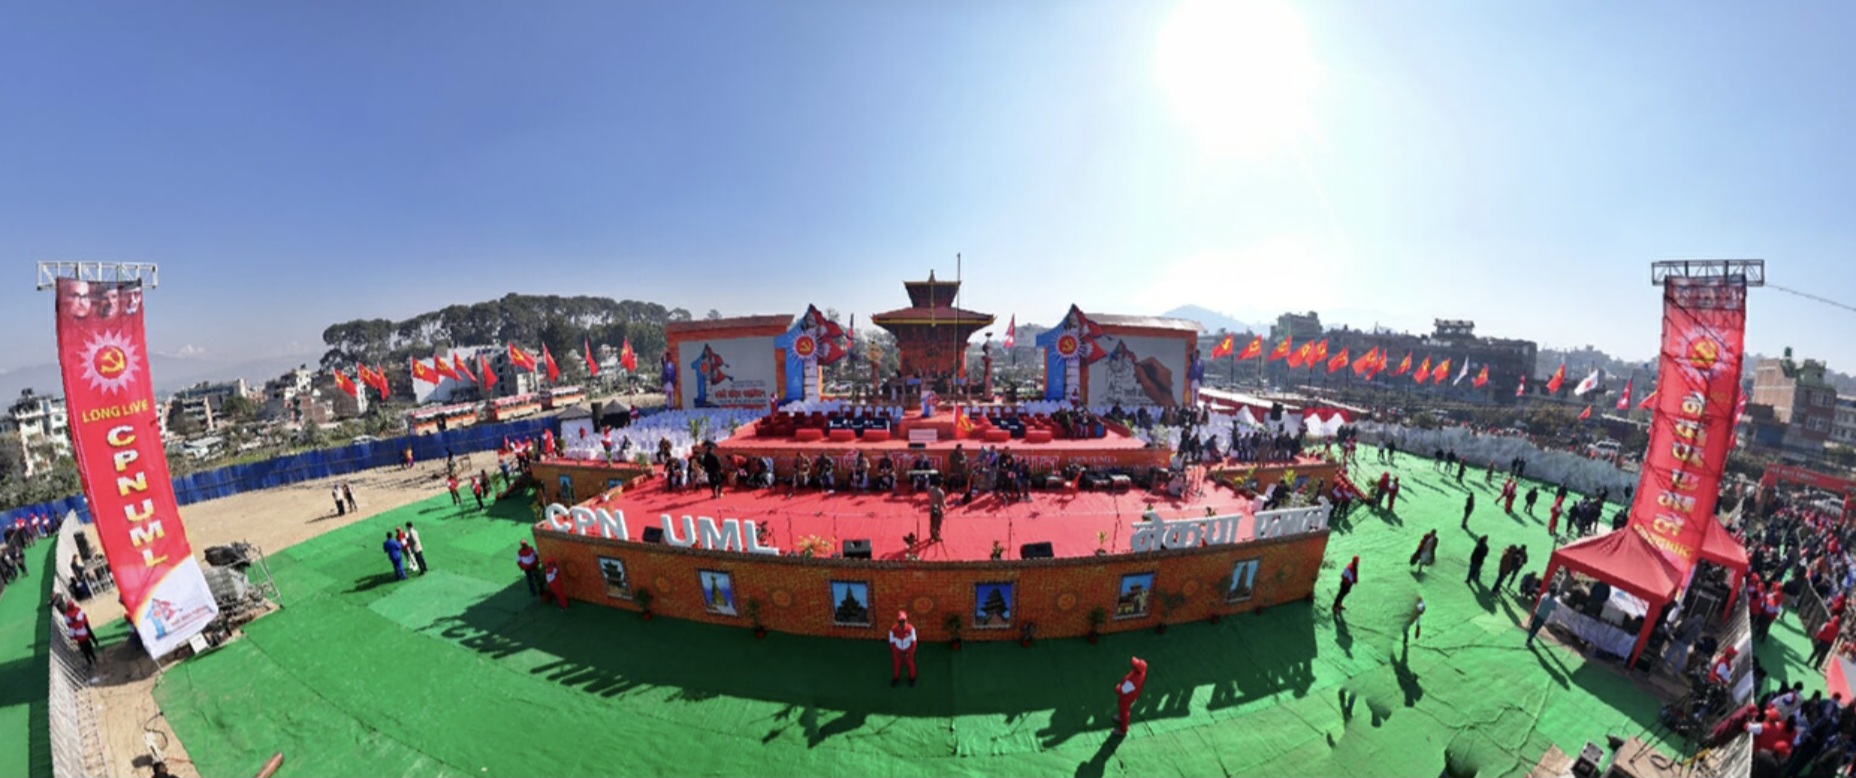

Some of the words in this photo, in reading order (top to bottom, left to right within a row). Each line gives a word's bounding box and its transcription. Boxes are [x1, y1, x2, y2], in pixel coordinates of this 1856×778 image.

[82, 406, 120, 423] LONG
[123, 399, 148, 416] LIVE
[545, 503, 629, 541] CPN
[660, 514, 780, 556] UML
